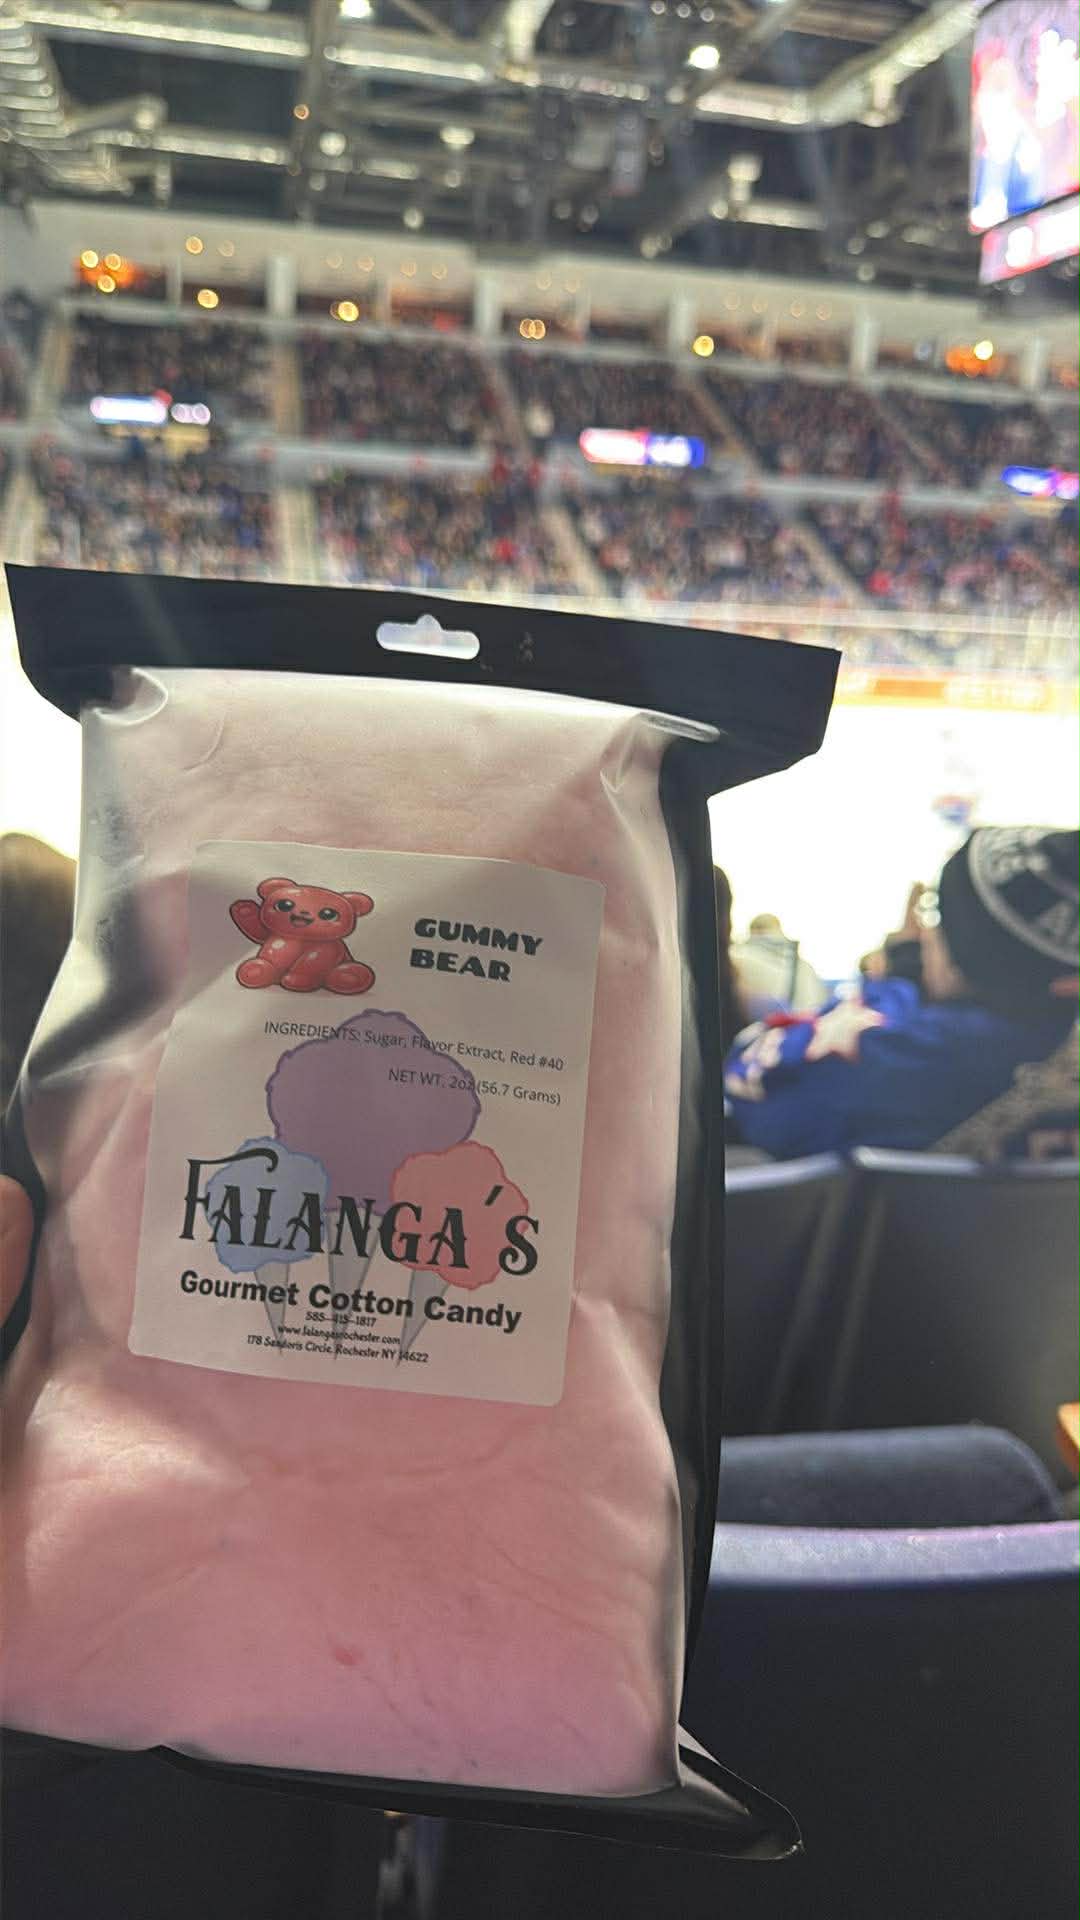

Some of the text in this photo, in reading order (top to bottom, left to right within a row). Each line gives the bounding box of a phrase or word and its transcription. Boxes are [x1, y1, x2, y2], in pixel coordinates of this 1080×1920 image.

[415, 918, 543, 956] GUMMY
[410, 948, 511, 982] BEAR
[264, 1021, 564, 1071] INGREDIENTS: Sugar, Flavor Extract, Red #40
[388, 1068, 561, 1105] NET WT. 2oz (56.7 Grams)
[180, 1270, 522, 1334] Gourmet Cotton Candy
[247, 1334, 263, 1345] 178
[334, 1344, 380, 1359] Rochester
[382, 1348, 396, 1361] NY
